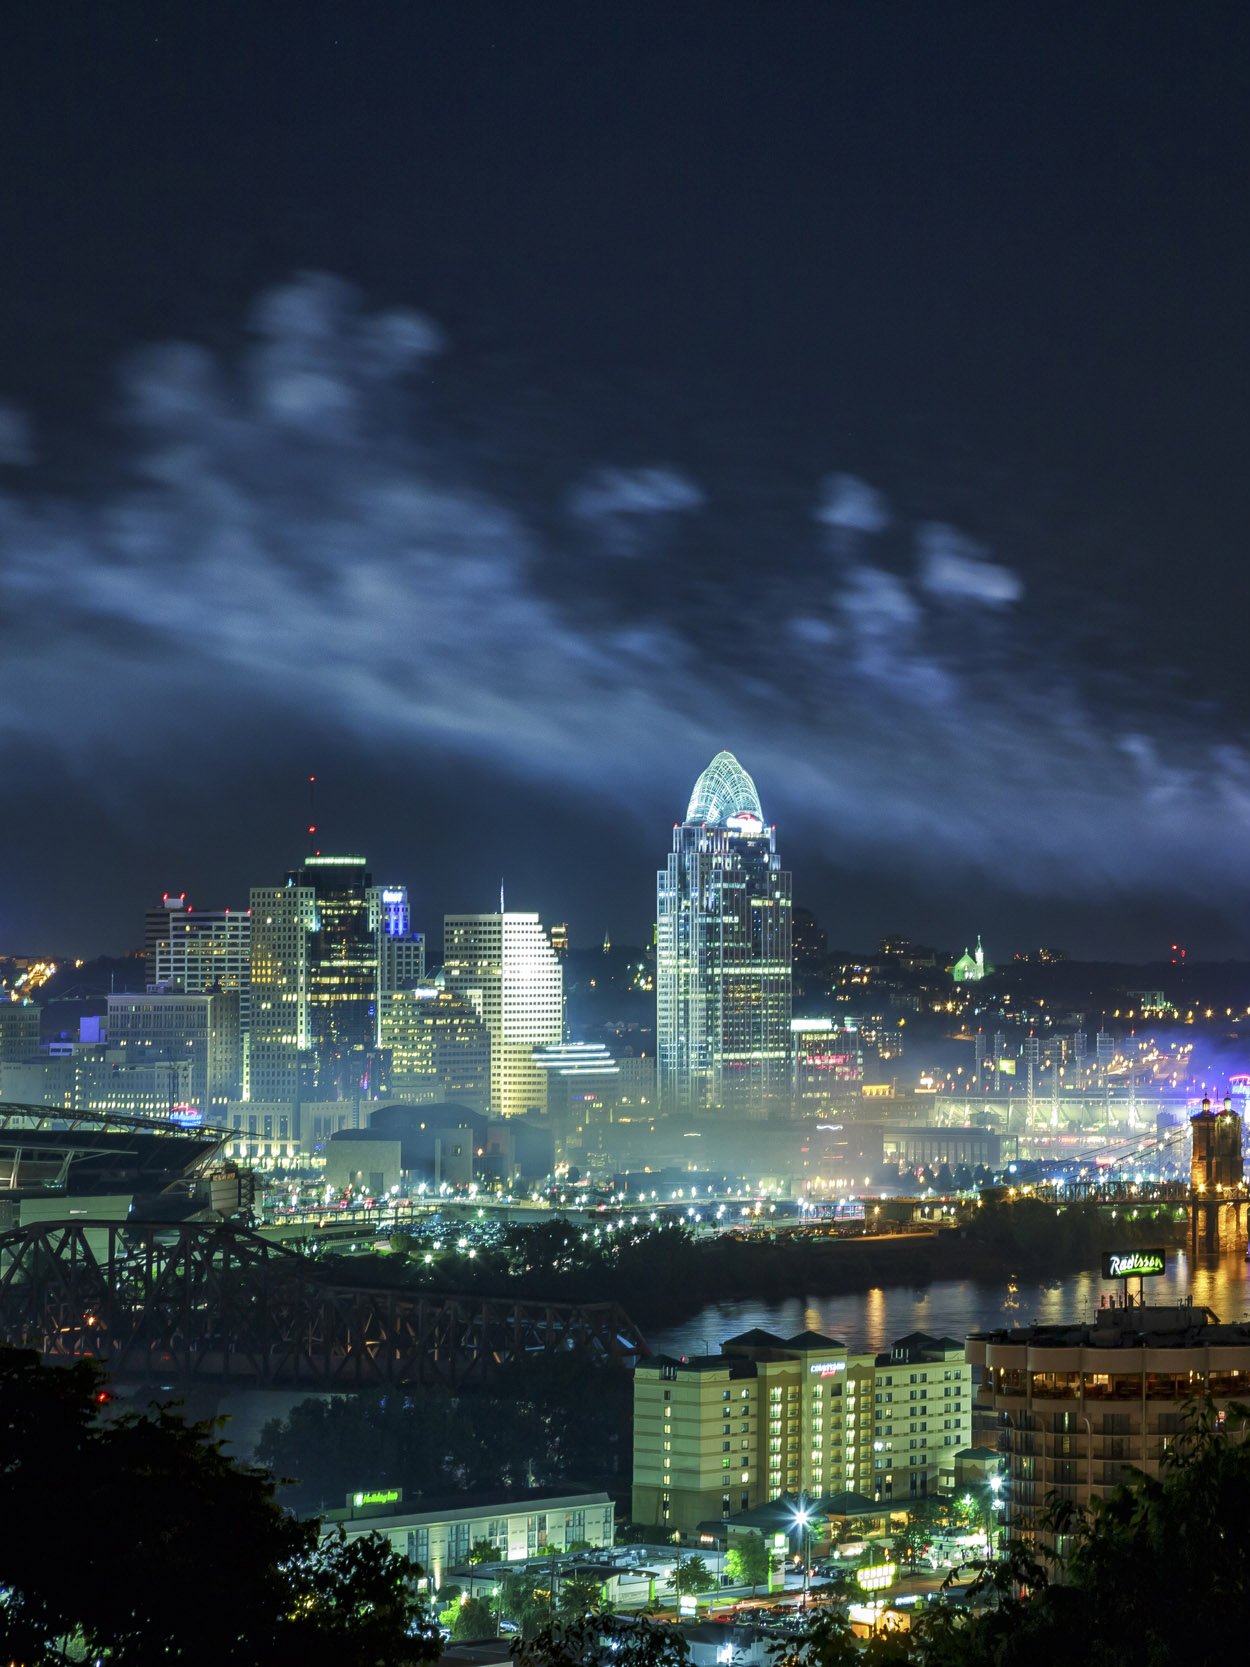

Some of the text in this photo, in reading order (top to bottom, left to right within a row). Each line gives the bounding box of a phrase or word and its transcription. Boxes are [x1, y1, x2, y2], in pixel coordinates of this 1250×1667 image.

[1110, 1253, 1163, 1275] Radisson
[363, 1490, 398, 1504] Holiday Inn
